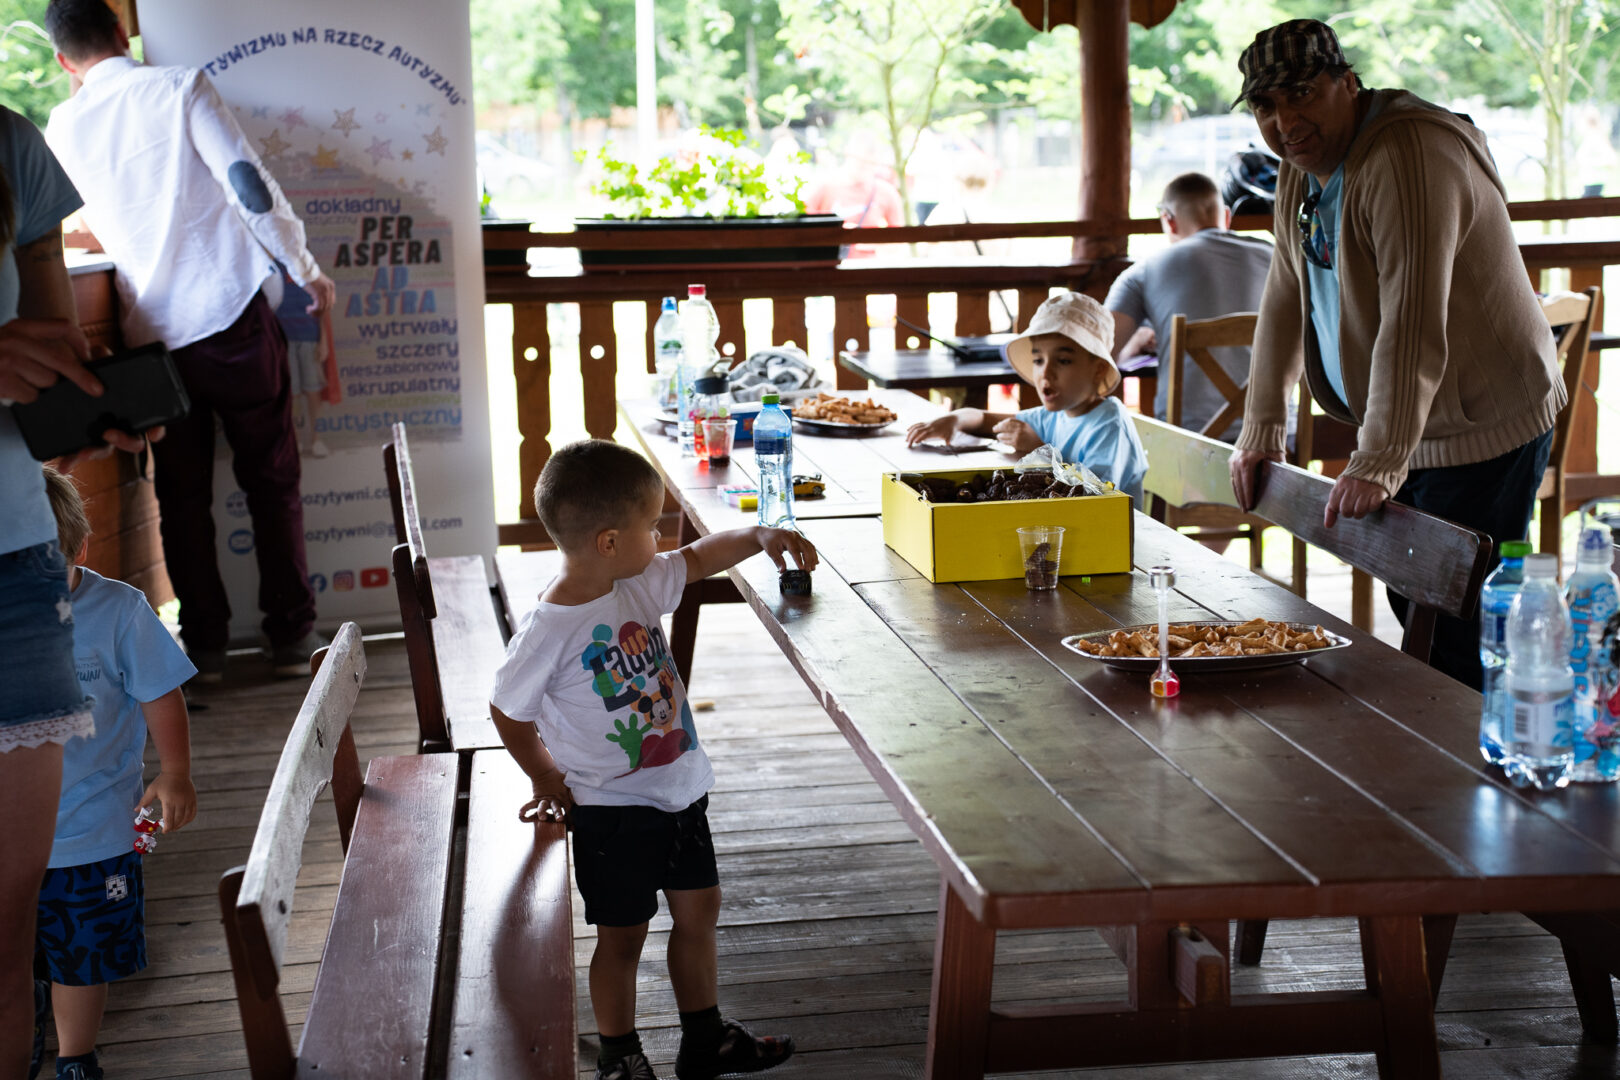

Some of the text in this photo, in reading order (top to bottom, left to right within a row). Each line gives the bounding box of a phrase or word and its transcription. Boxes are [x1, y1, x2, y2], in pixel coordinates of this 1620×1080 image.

[204, 33, 287, 76] TYWIZMU
[292, 27, 317, 44] NA
[324, 28, 386, 57] RZECZ
[305, 197, 401, 215] dokładny
[361, 216, 413, 241] PER
[334, 240, 441, 267] ASPERA
[371, 266, 408, 291] AD
[345, 289, 437, 317] ASTRA
[358, 318, 457, 338] wytrwały
[376, 342, 459, 360] szczery
[347, 378, 460, 396] skrupulatny
[314, 407, 463, 433] autystyczny
[302, 486, 391, 507] ozytywni.co
